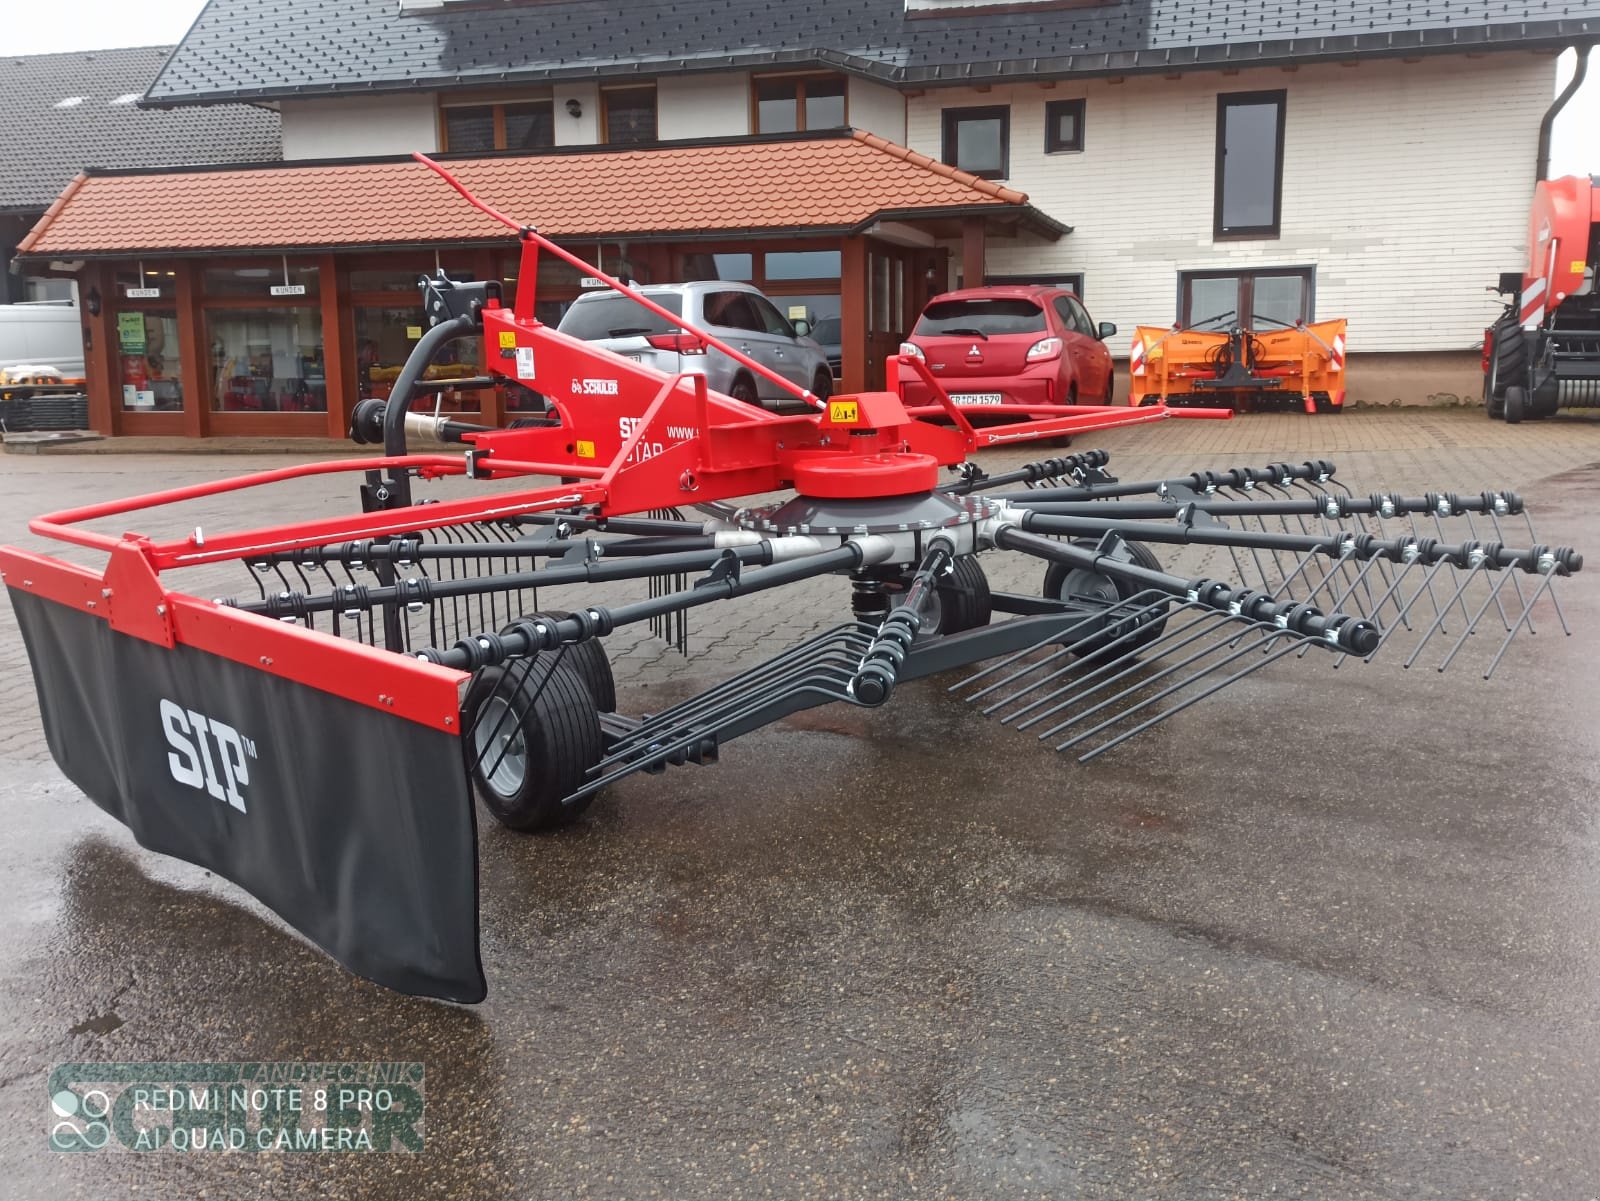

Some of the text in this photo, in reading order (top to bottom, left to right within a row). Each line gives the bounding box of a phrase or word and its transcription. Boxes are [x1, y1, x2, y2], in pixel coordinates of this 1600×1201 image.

[966, 395, 978, 405] CH
[980, 394, 1000, 405] 1579
[160, 698, 249, 814] SIP
